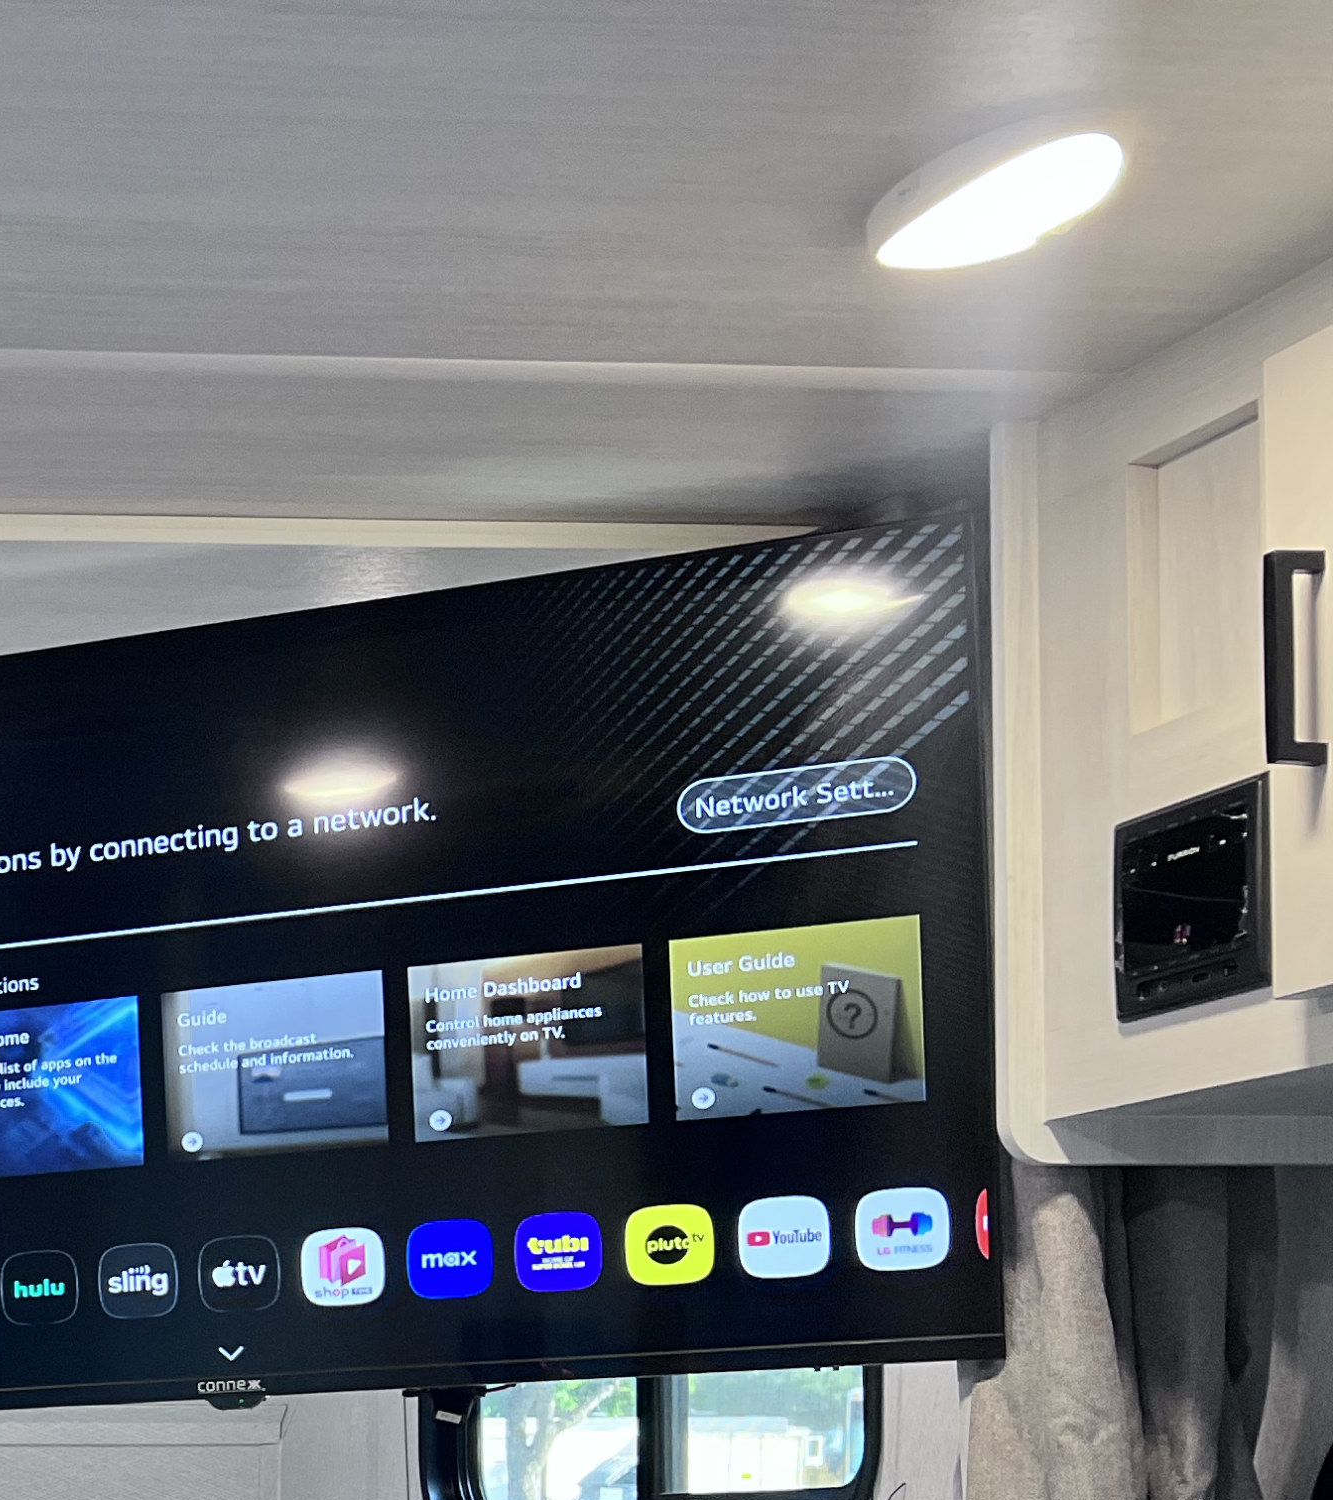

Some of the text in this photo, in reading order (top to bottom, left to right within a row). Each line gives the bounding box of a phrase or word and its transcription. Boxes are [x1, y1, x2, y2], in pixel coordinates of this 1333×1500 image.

[695, 780, 894, 818] Network Sett...
[50, 842, 82, 872] by
[89, 824, 239, 862] connecting
[246, 820, 279, 842] to
[287, 817, 304, 838] a
[313, 797, 437, 834] network.
[687, 952, 795, 977] User Guide
[425, 972, 581, 1003] Home Dashboard
[688, 980, 849, 1008] Check how to use TV
[177, 1010, 227, 1027] Guide
[426, 1005, 602, 1032] Control home appliances
[689, 1009, 757, 1026] features.
[178, 1033, 317, 1057] Check the broadcast
[426, 1026, 565, 1050] conveniently on TV.
[0, 1062, 20, 1075] list
[23, 1060, 37, 1072] of
[41, 1059, 71, 1072] apps
[75, 1057, 91, 1066] on
[95, 1053, 117, 1065] the
[179, 1048, 354, 1074] schedule and information.
[4, 1075, 49, 1091] include
[53, 1074, 82, 1089] your
[527, 1234, 589, 1254] tubi
[647, 1233, 704, 1254] pluto tv
[773, 1228, 822, 1244] YouTube
[422, 1250, 477, 1268] max
[14, 1279, 65, 1298] hulu
[108, 1266, 169, 1296] sling
[315, 1286, 349, 1299] shop
